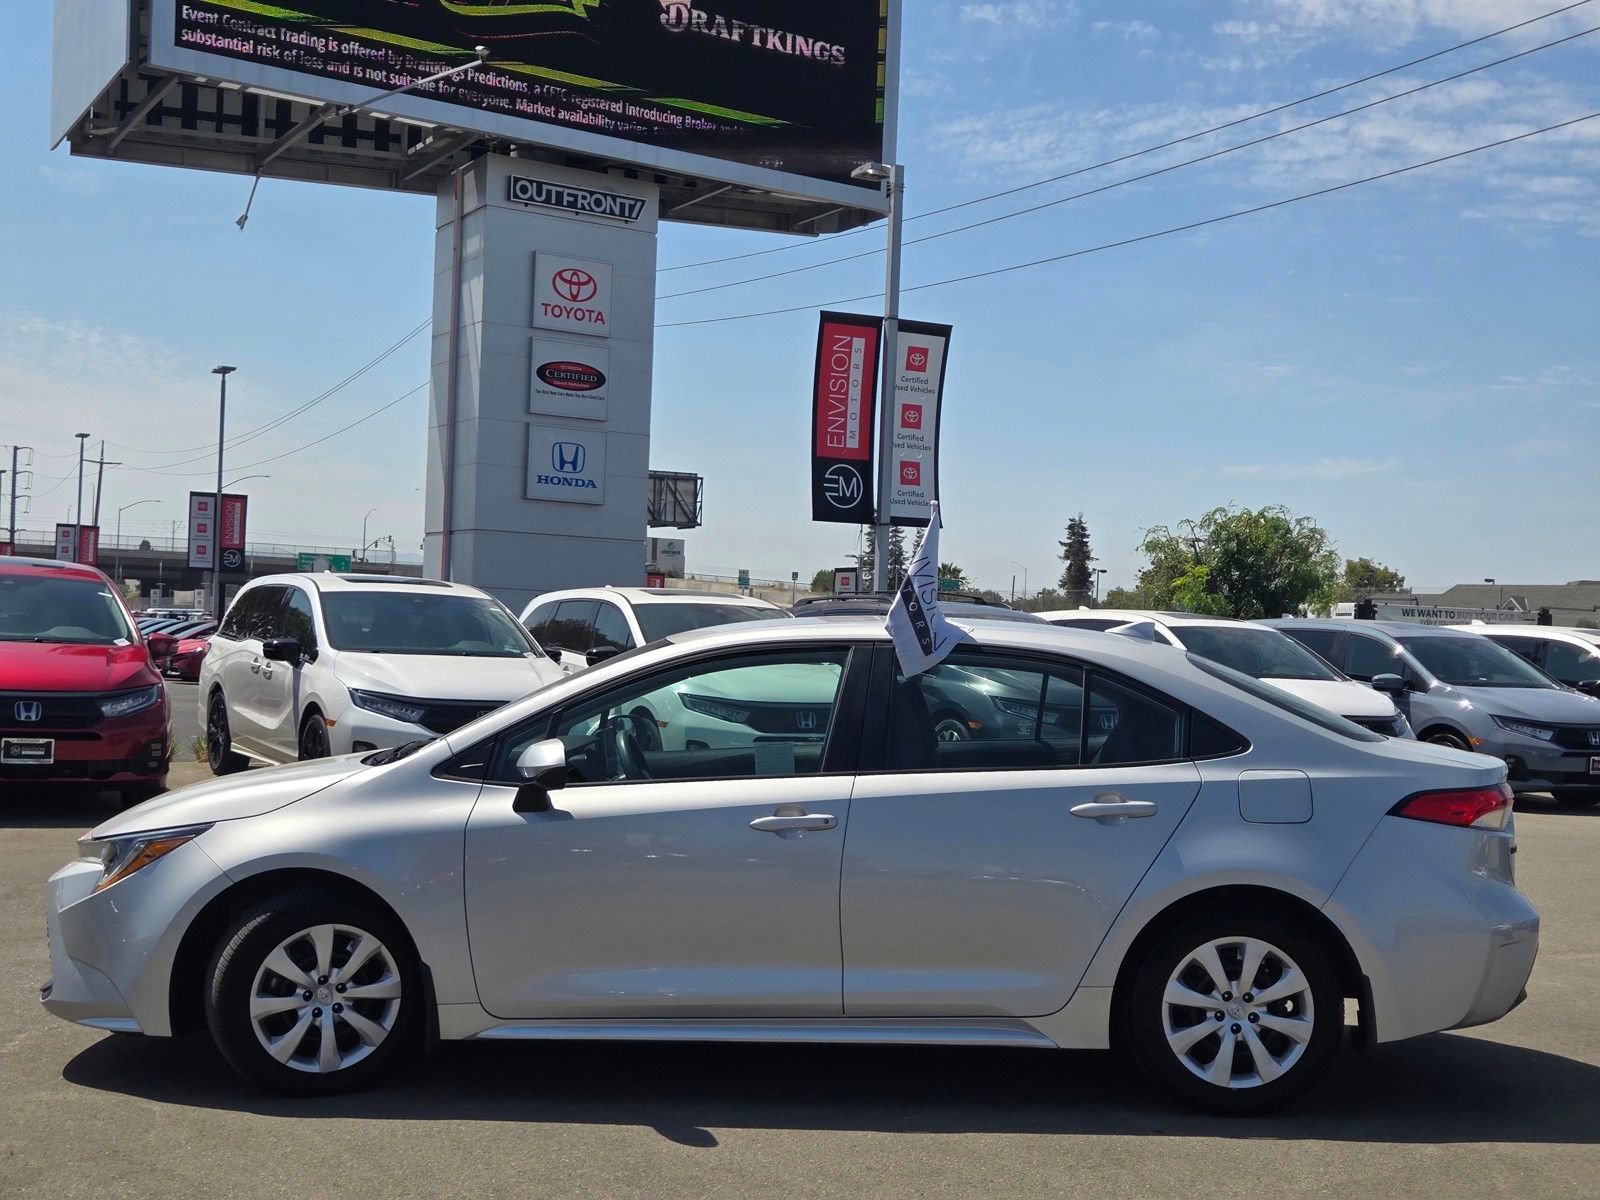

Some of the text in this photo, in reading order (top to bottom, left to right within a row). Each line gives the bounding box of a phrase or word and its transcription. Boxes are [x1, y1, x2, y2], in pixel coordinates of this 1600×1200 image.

[182, 5, 219, 24] Event
[280, 28, 326, 53] Trading
[328, 37, 338, 52] is
[341, 41, 385, 61] offered
[625, 102, 683, 128] Introducing
[181, 28, 254, 53] substantial
[257, 42, 280, 59] risk
[284, 49, 298, 60] of
[354, 63, 363, 77] is
[366, 67, 387, 82] not
[438, 80, 456, 93] for
[515, 98, 555, 118] Market
[558, 109, 615, 131] availability
[541, 302, 605, 325] TOYOTA
[900, 375, 929, 385] Certified
[827, 335, 851, 447] ENVISION
[849, 347, 862, 439] MOTORS
[910, 385, 935, 394] Vehicles
[897, 432, 925, 441] Certified
[906, 442, 931, 451] Vehicles
[536, 474, 598, 489] HONDA
[897, 490, 925, 498] Certified
[1401, 608, 1416, 617] WE
[1417, 608, 1442, 619] WANT
[1444, 610, 1456, 619] TO
[1457, 611, 1472, 620] BUY
[1474, 612, 1497, 621] YOUR
